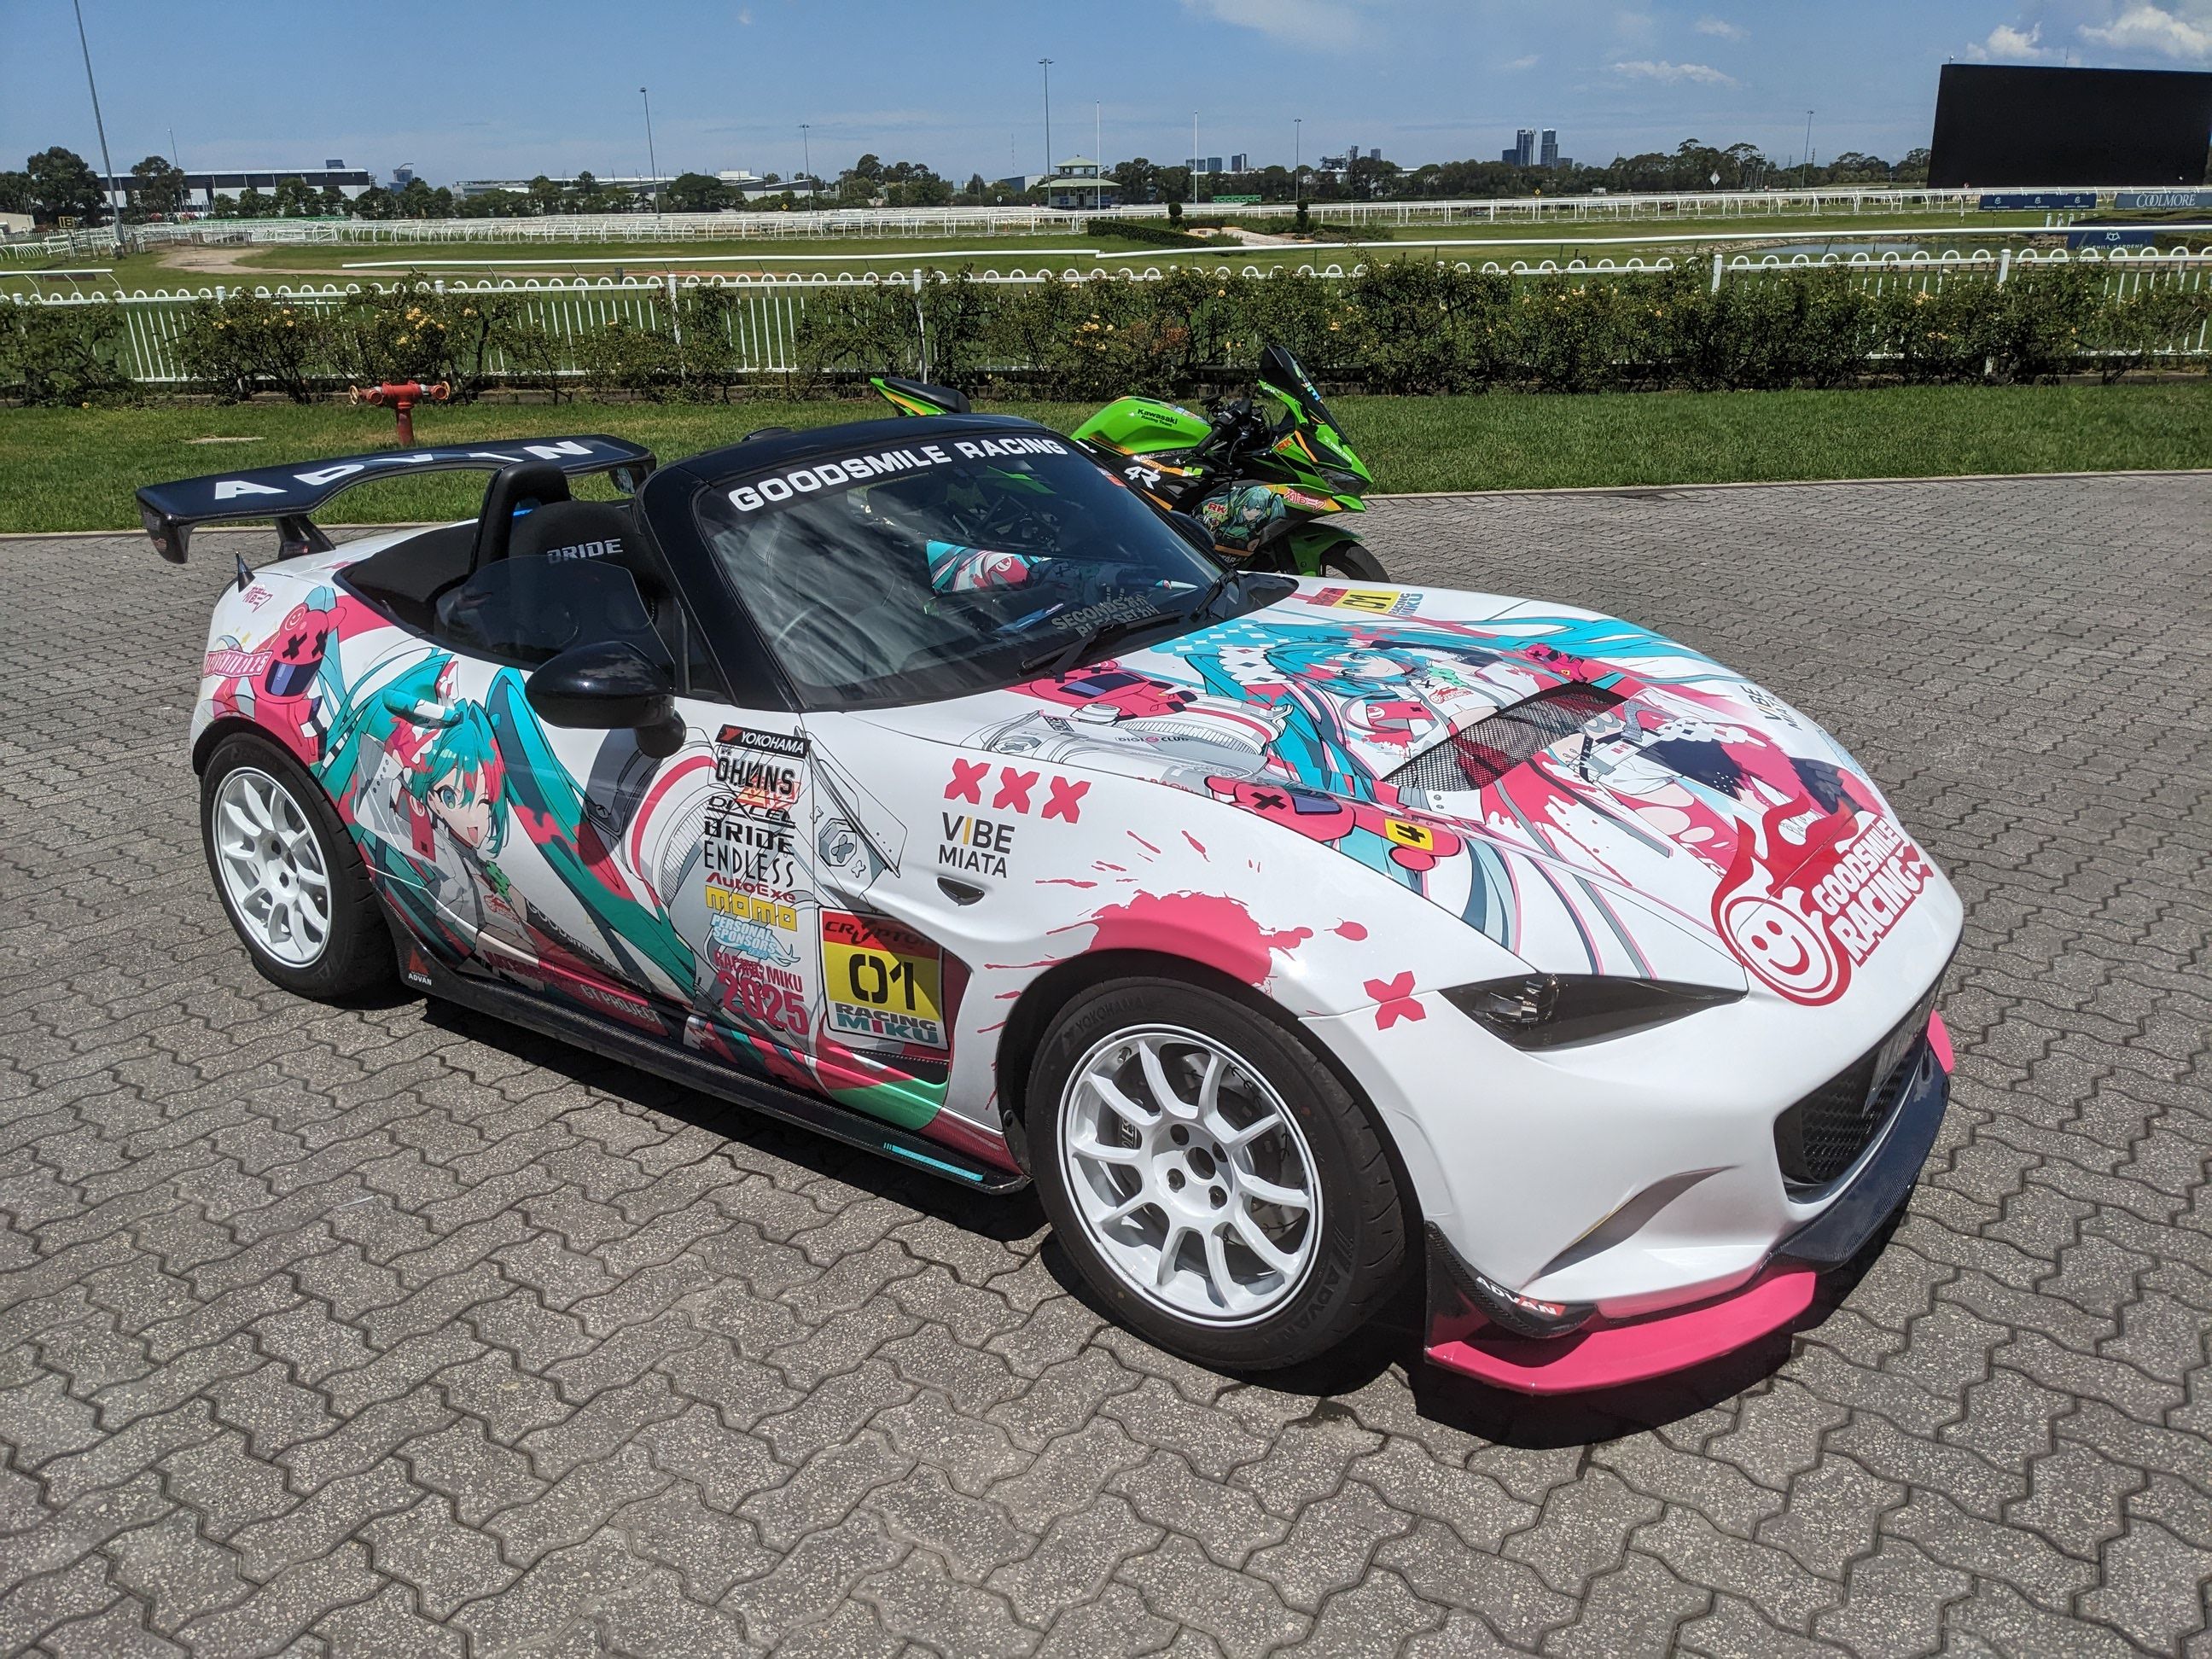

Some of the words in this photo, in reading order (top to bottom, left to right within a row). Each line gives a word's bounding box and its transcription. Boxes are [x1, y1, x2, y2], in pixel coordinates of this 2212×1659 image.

[2136, 194, 2197, 207] COOLMORE
[1137, 409, 1179, 425] Kawasaki
[728, 445, 952, 512] GOODSMILE
[953, 437, 1068, 460] RACING
[1124, 466, 1161, 490] 4R
[1208, 503, 1227, 514] RK
[1051, 597, 1128, 630] SECONDS
[1740, 684, 1783, 721] VIBE
[741, 731, 805, 754] YOKOHAMA
[715, 749, 795, 795] ÖHLINS
[708, 795, 792, 823] DIXCEL
[704, 815, 795, 856] BRIDE
[942, 812, 1016, 854] VIBE
[704, 841, 794, 888] ENDLESS
[939, 844, 1008, 879] MIATA
[1811, 819, 1901, 917] GOODSMILE
[706, 871, 796, 903] AutoExe
[1829, 854, 1922, 962] RACING
[711, 913, 773, 940] PERSONAL
[713, 927, 777, 954] SPONSORS
[408, 973, 433, 986] ADVAN
[713, 950, 765, 980] RACING
[766, 965, 803, 992] MIKU
[849, 953, 917, 1011] 01
[717, 969, 810, 1035] 2025
[835, 1003, 937, 1032] RACING
[836, 1013, 939, 1044] MIKU
[1476, 1276, 1557, 1315] ADVAN
